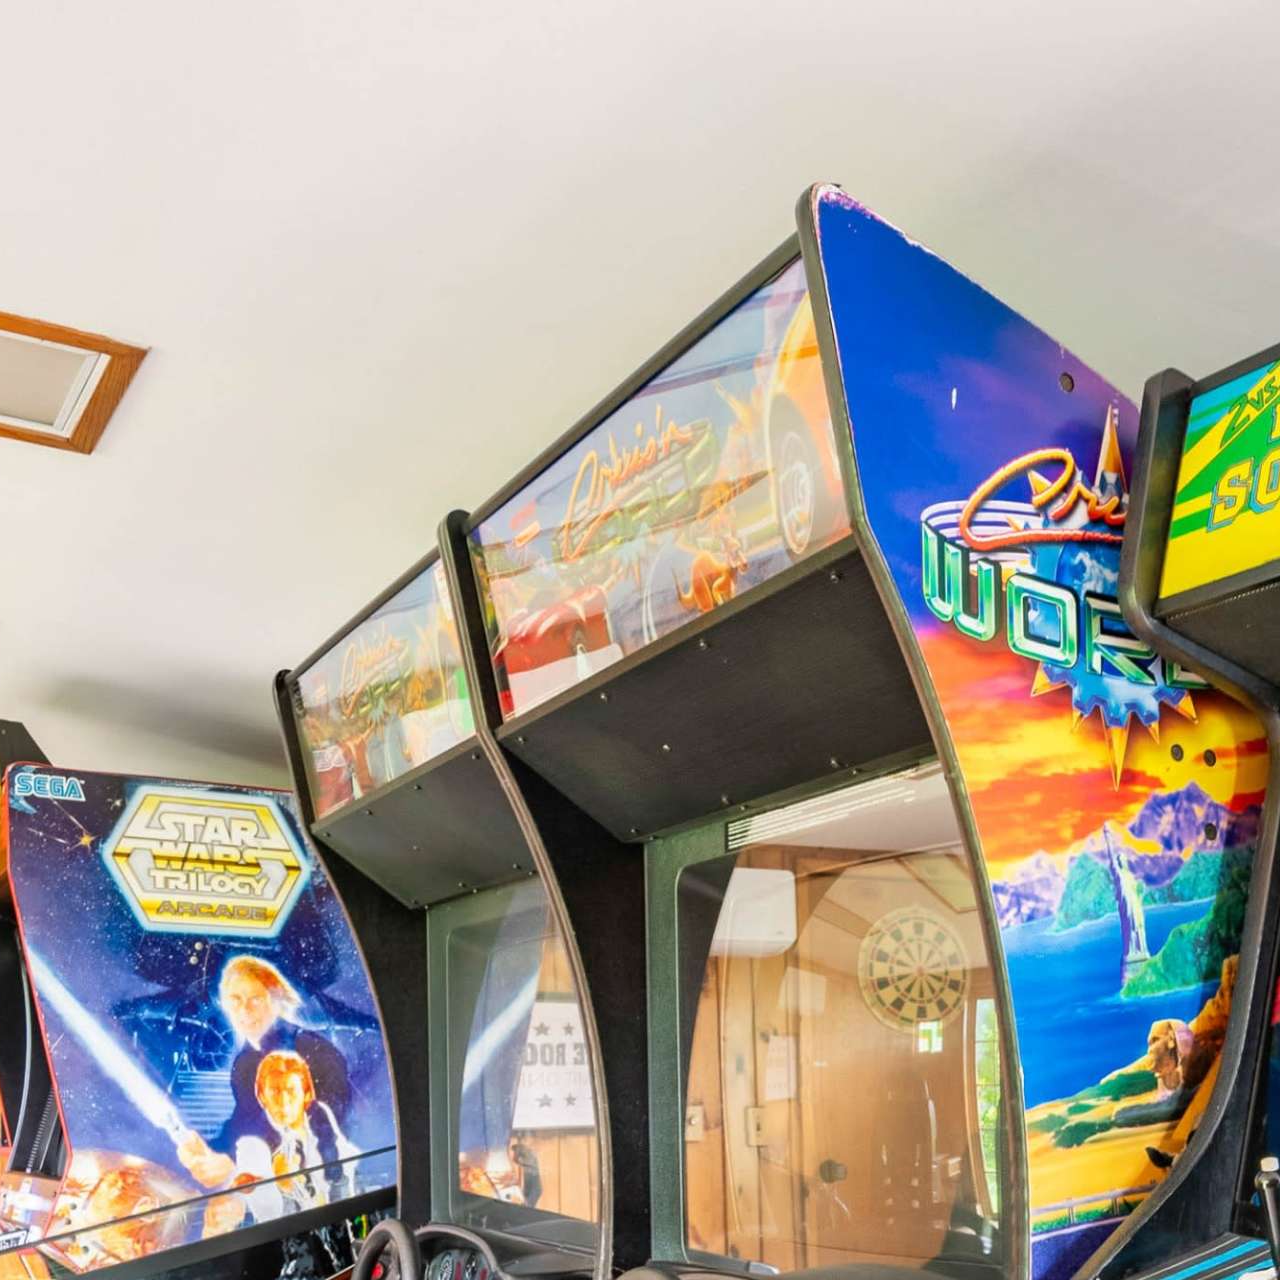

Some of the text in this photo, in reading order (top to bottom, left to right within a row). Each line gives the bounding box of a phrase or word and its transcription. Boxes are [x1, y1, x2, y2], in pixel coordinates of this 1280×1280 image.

[15, 773, 86, 802] SEGA
[148, 811, 270, 850] STAR
[148, 841, 276, 876] WARS
[149, 868, 270, 897] TRILOGY
[156, 900, 269, 921] ARCADE
